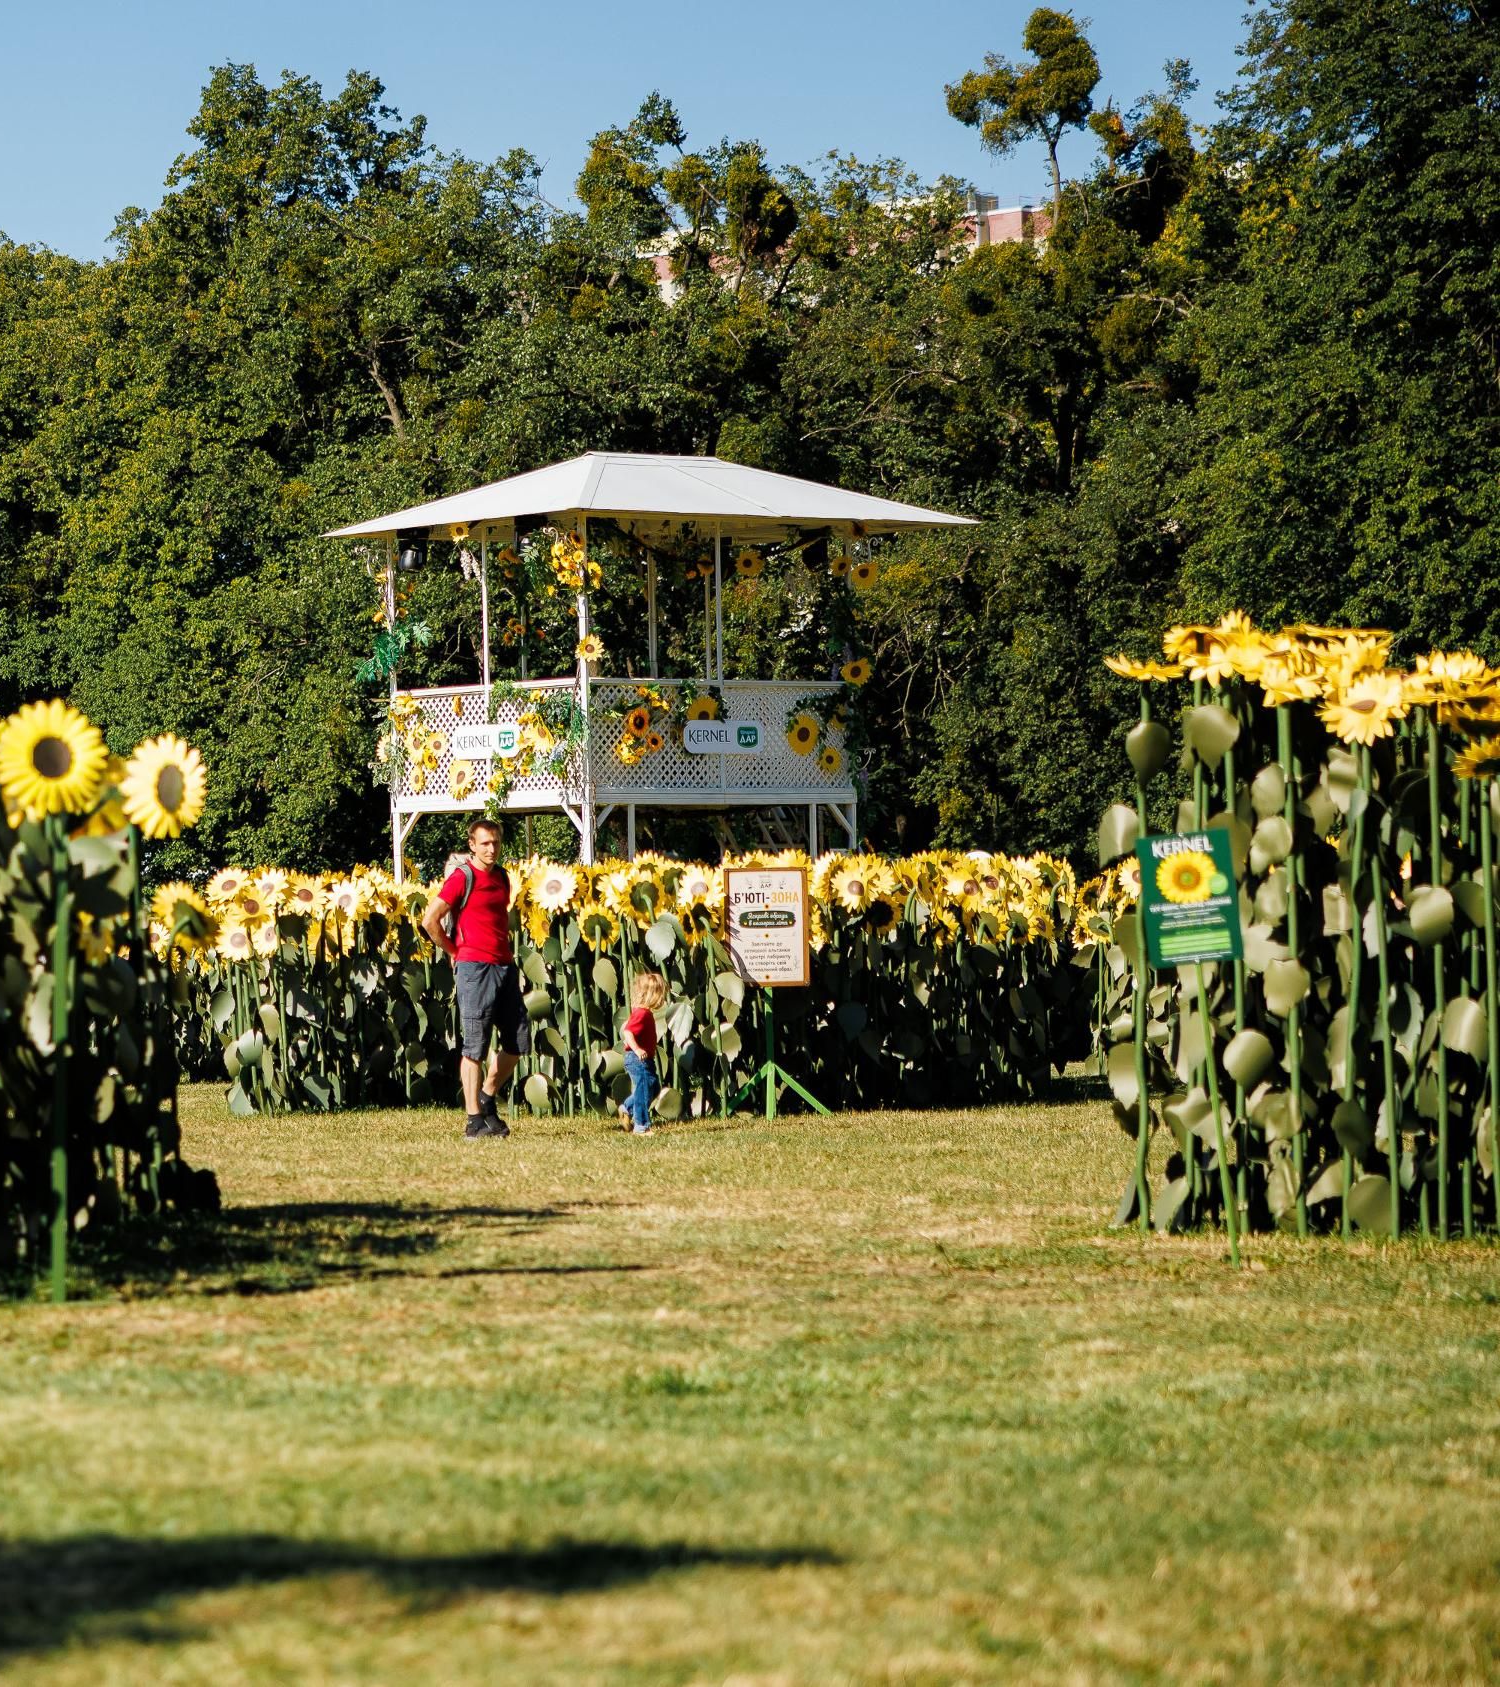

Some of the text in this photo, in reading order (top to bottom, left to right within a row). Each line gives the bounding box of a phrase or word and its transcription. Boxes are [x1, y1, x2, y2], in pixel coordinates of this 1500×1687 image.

[456, 735, 492, 751] KERNEL
[688, 729, 731, 744] KERNEL
[739, 735, 756, 744] ДАР
[1151, 834, 1214, 859] KERNEL
